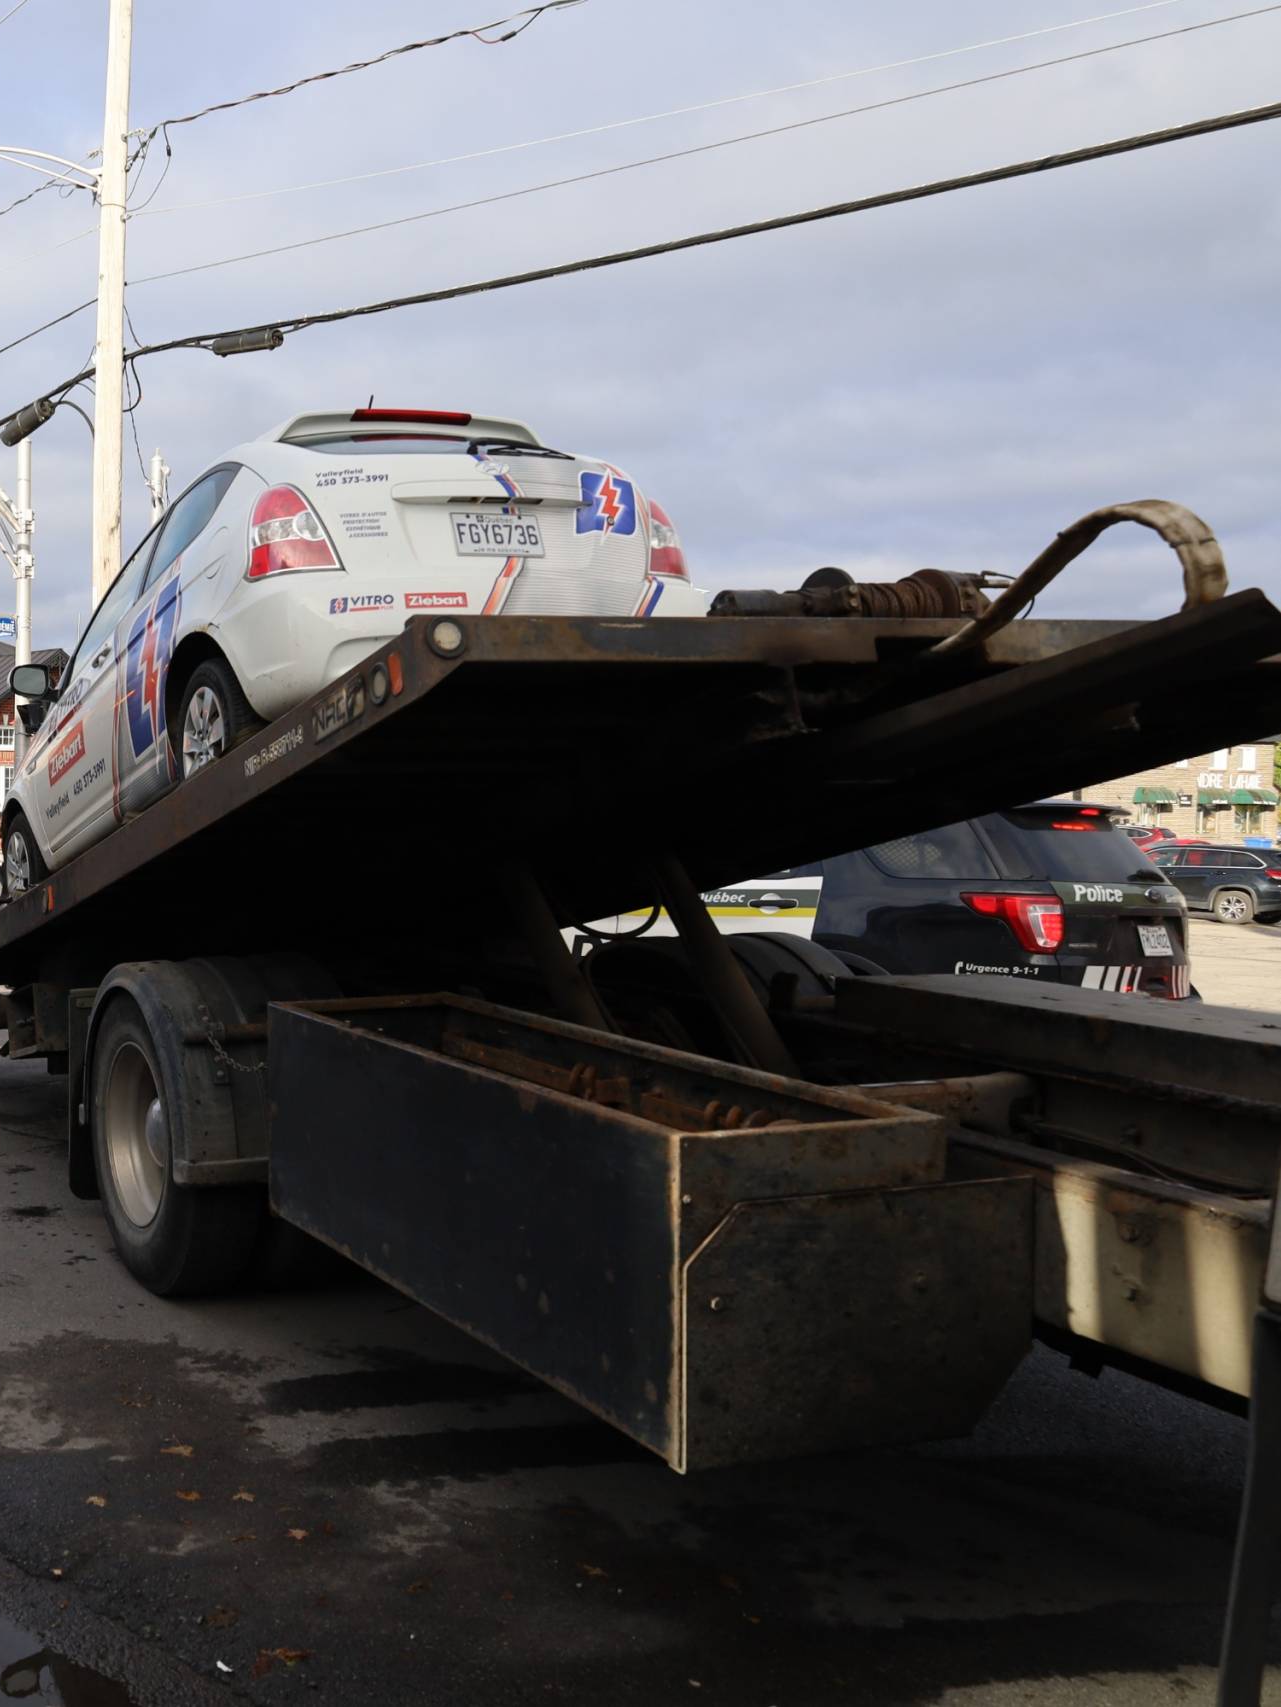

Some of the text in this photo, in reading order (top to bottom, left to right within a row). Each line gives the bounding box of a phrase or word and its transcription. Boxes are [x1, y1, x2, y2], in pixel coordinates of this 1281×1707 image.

[315, 468, 363, 478] Valleyfield
[316, 474, 389, 487] 450 373-3991
[456, 523, 539, 545] FGY6736
[350, 594, 394, 606] VITRO
[409, 596, 464, 607] Ziebart
[49, 733, 82, 779] Ziebart
[72, 779, 83, 796] 450
[83, 758, 106, 788] 373-3991
[699, 892, 746, 903] uébec
[1073, 884, 1124, 902] Police
[965, 963, 1039, 975] Urgence 9-1-1
